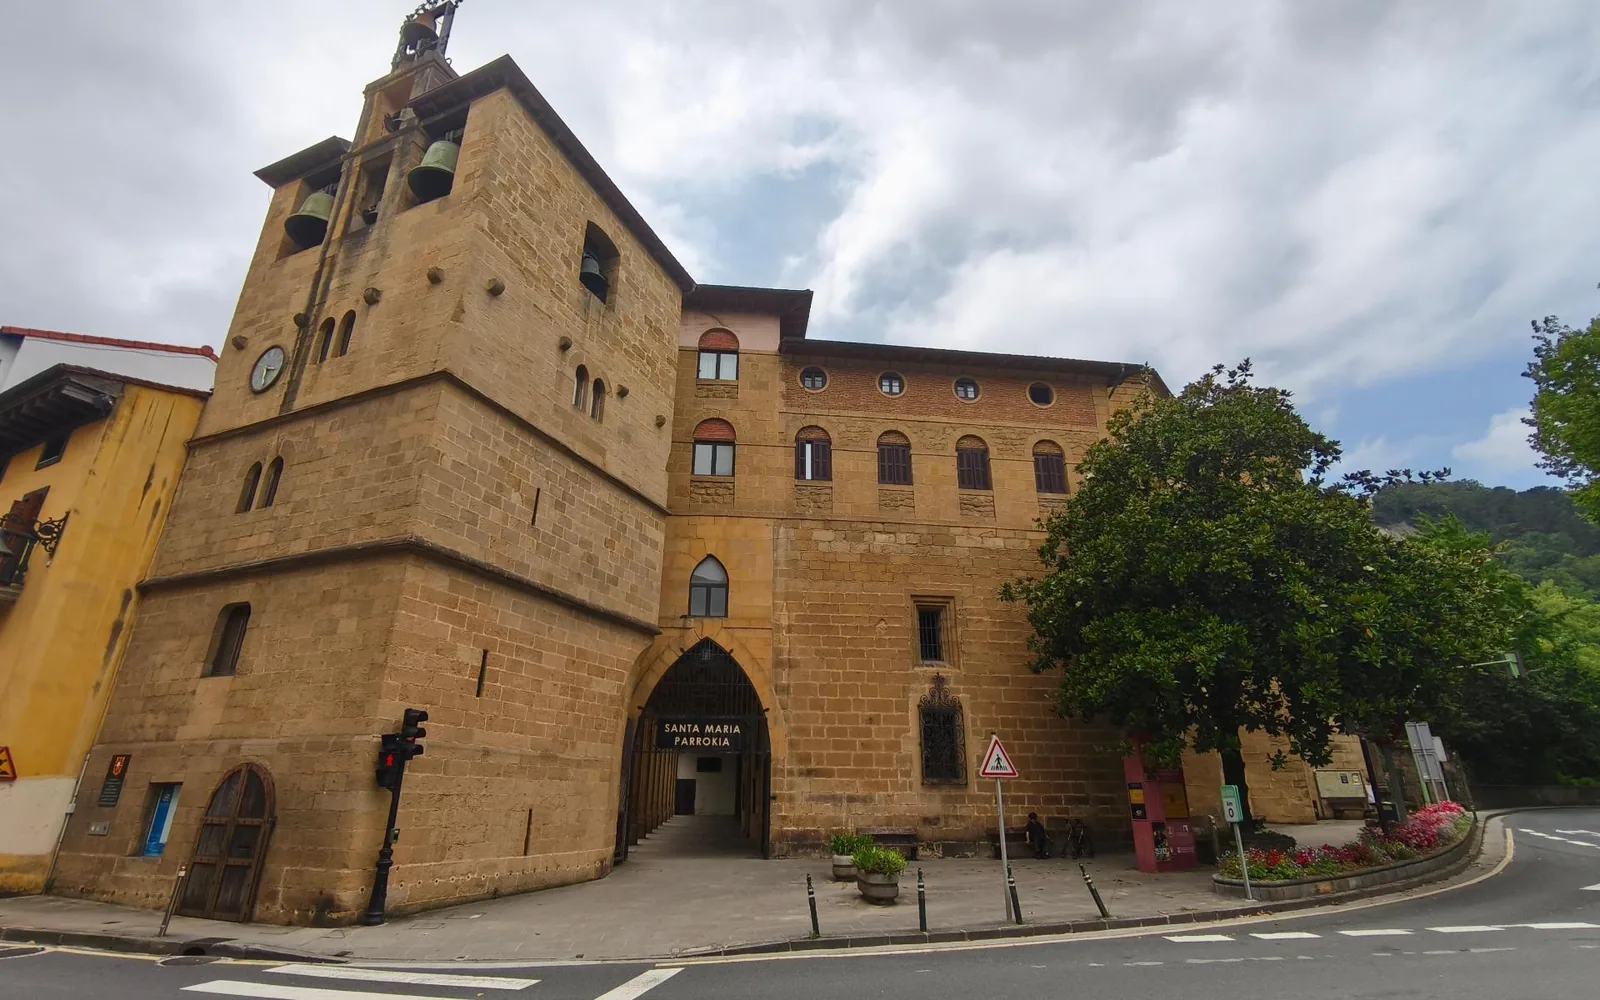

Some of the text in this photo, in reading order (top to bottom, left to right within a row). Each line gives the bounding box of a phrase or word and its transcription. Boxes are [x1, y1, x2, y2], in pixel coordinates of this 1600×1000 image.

[664, 723, 741, 734] SANTA MARIA
[674, 736, 730, 746] PARROKIA
